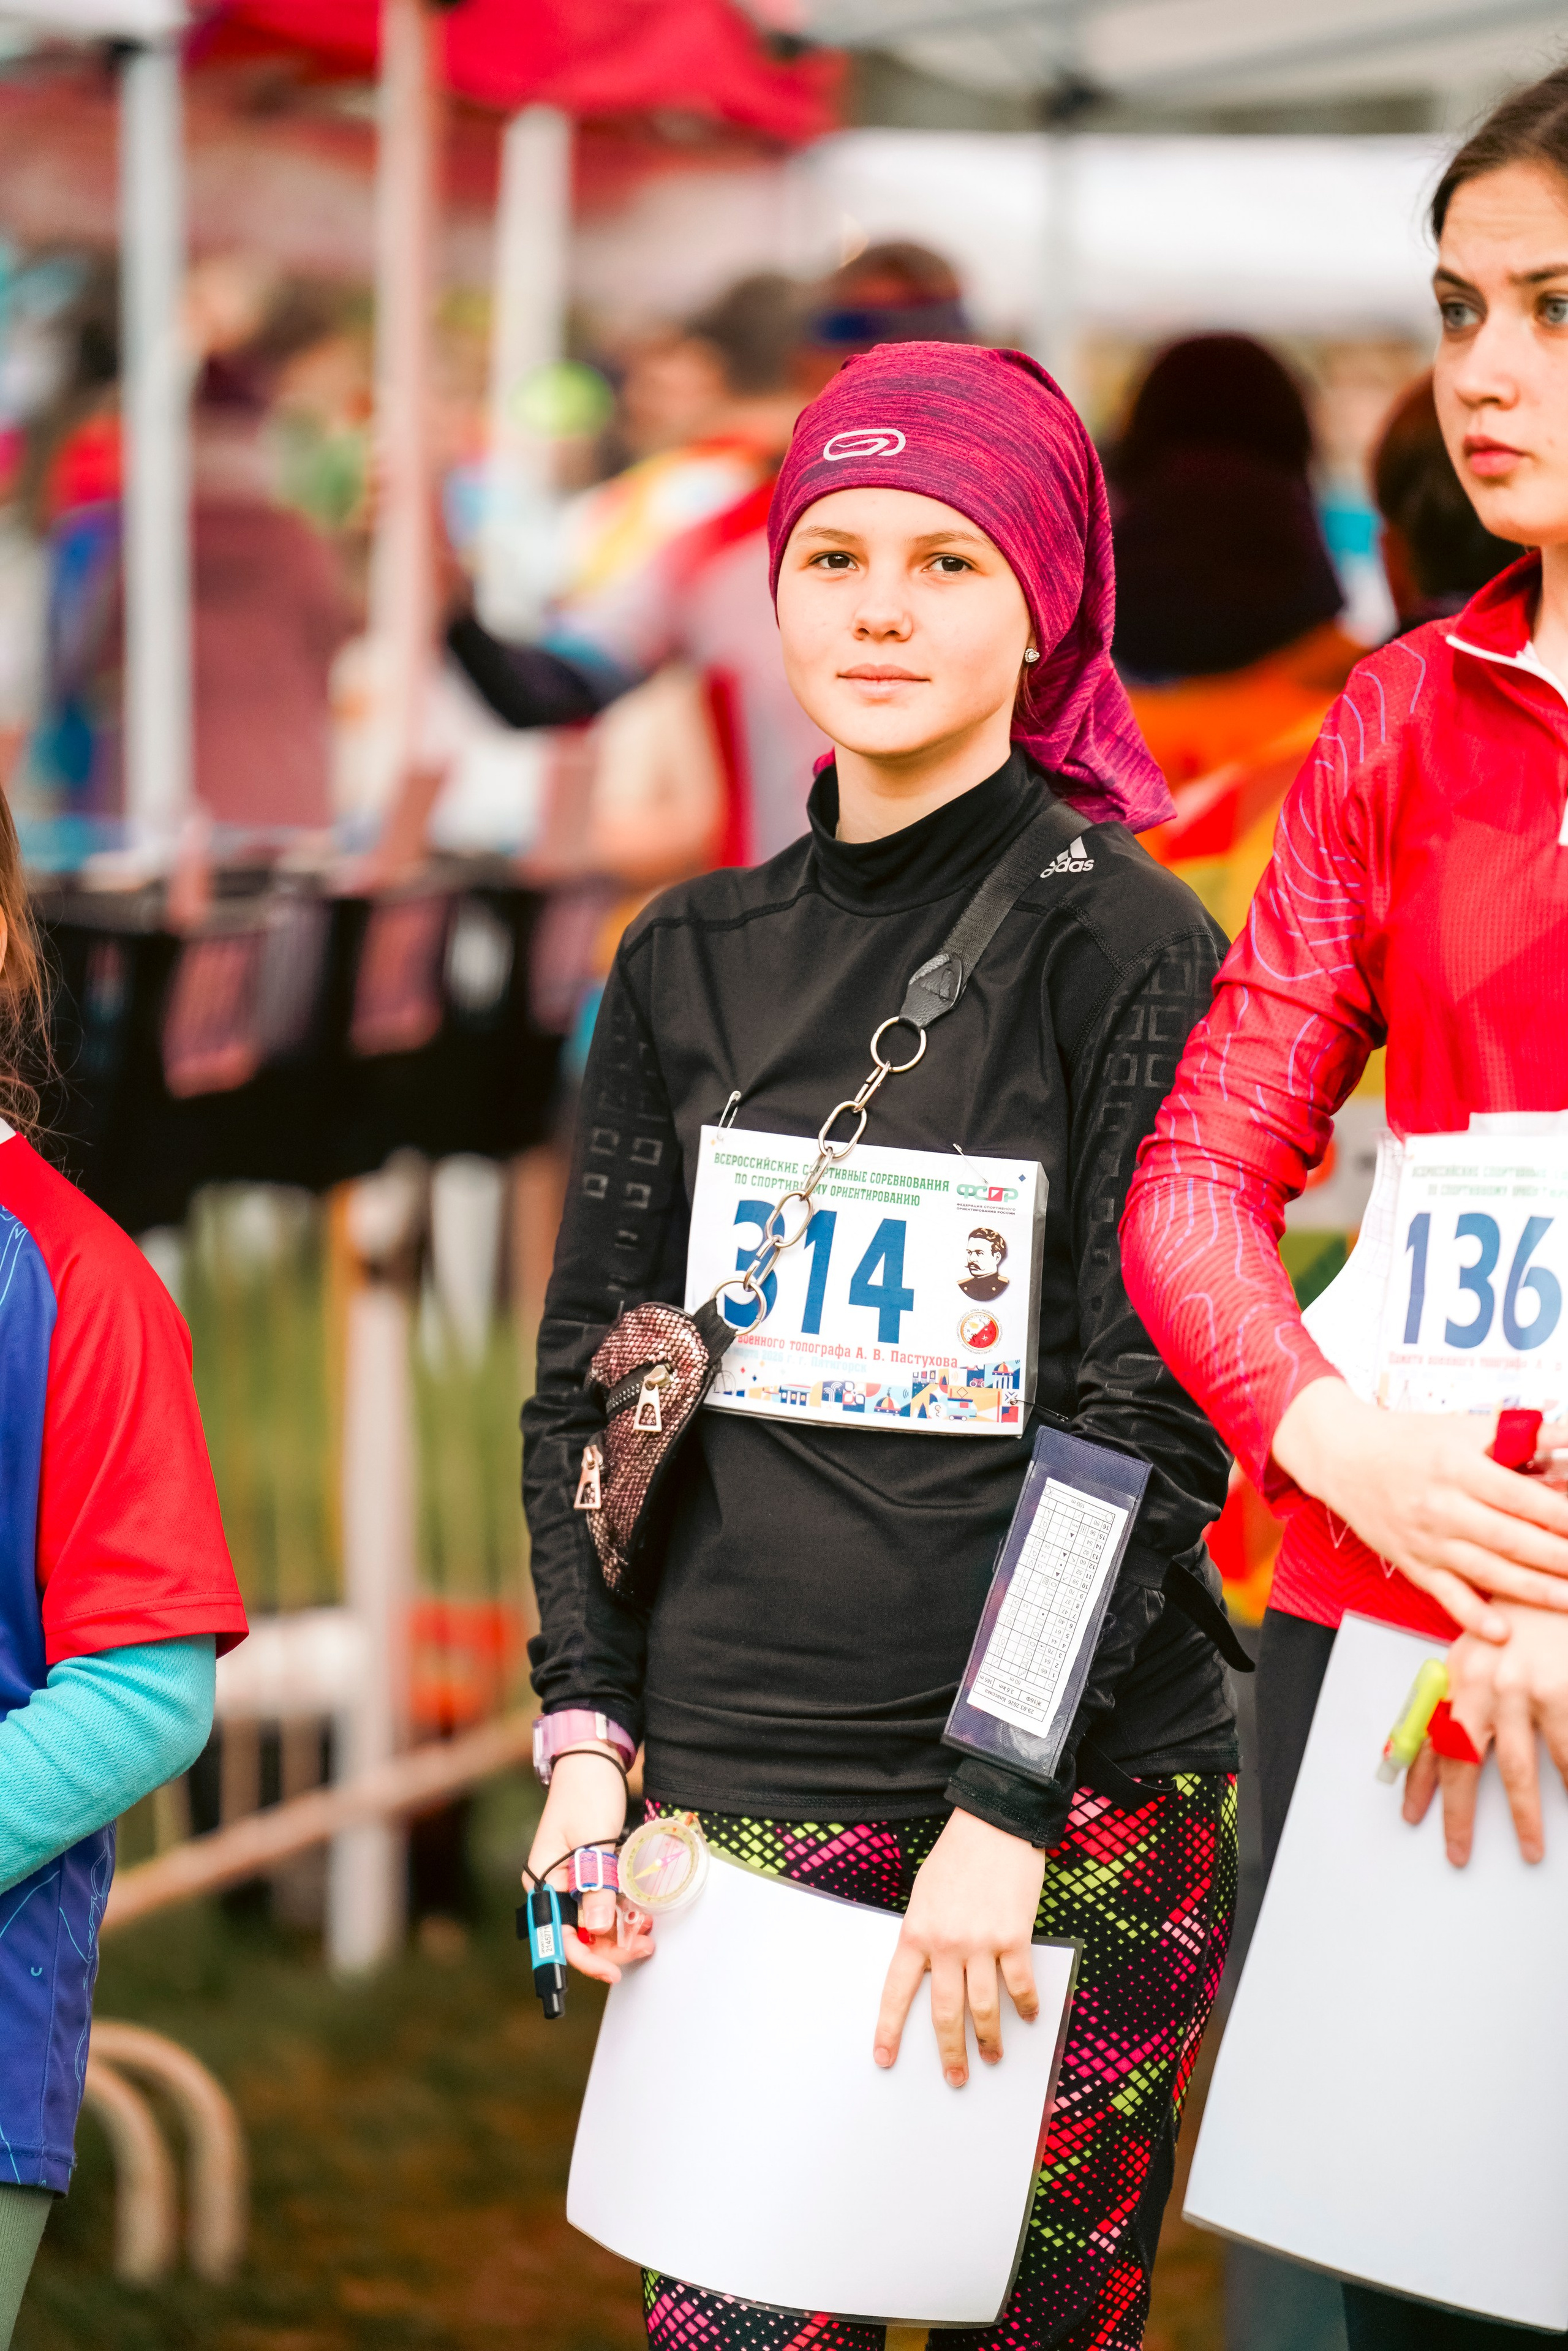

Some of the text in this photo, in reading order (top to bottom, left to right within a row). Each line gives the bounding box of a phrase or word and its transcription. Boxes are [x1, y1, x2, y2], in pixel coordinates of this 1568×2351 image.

[714, 1152, 799, 1174] ВСЕРОССИЙСКИЕ
[870, 1172, 950, 1192] СОРЕВНОВАНИЯ
[735, 1172, 921, 1207] ПО СПОРТИВМУ ОРИЕНТИРОВАНИЮ
[724, 1199, 914, 1344] 314
[1403, 1212, 1562, 1351] 136
[790, 1340, 851, 1359] топографа
[856, 1346, 867, 1360] А.
[873, 1348, 884, 1362] В.
[891, 1349, 958, 1368] Пастухова
[985, 1689, 1035, 1715] 29.03.2026 Классика
